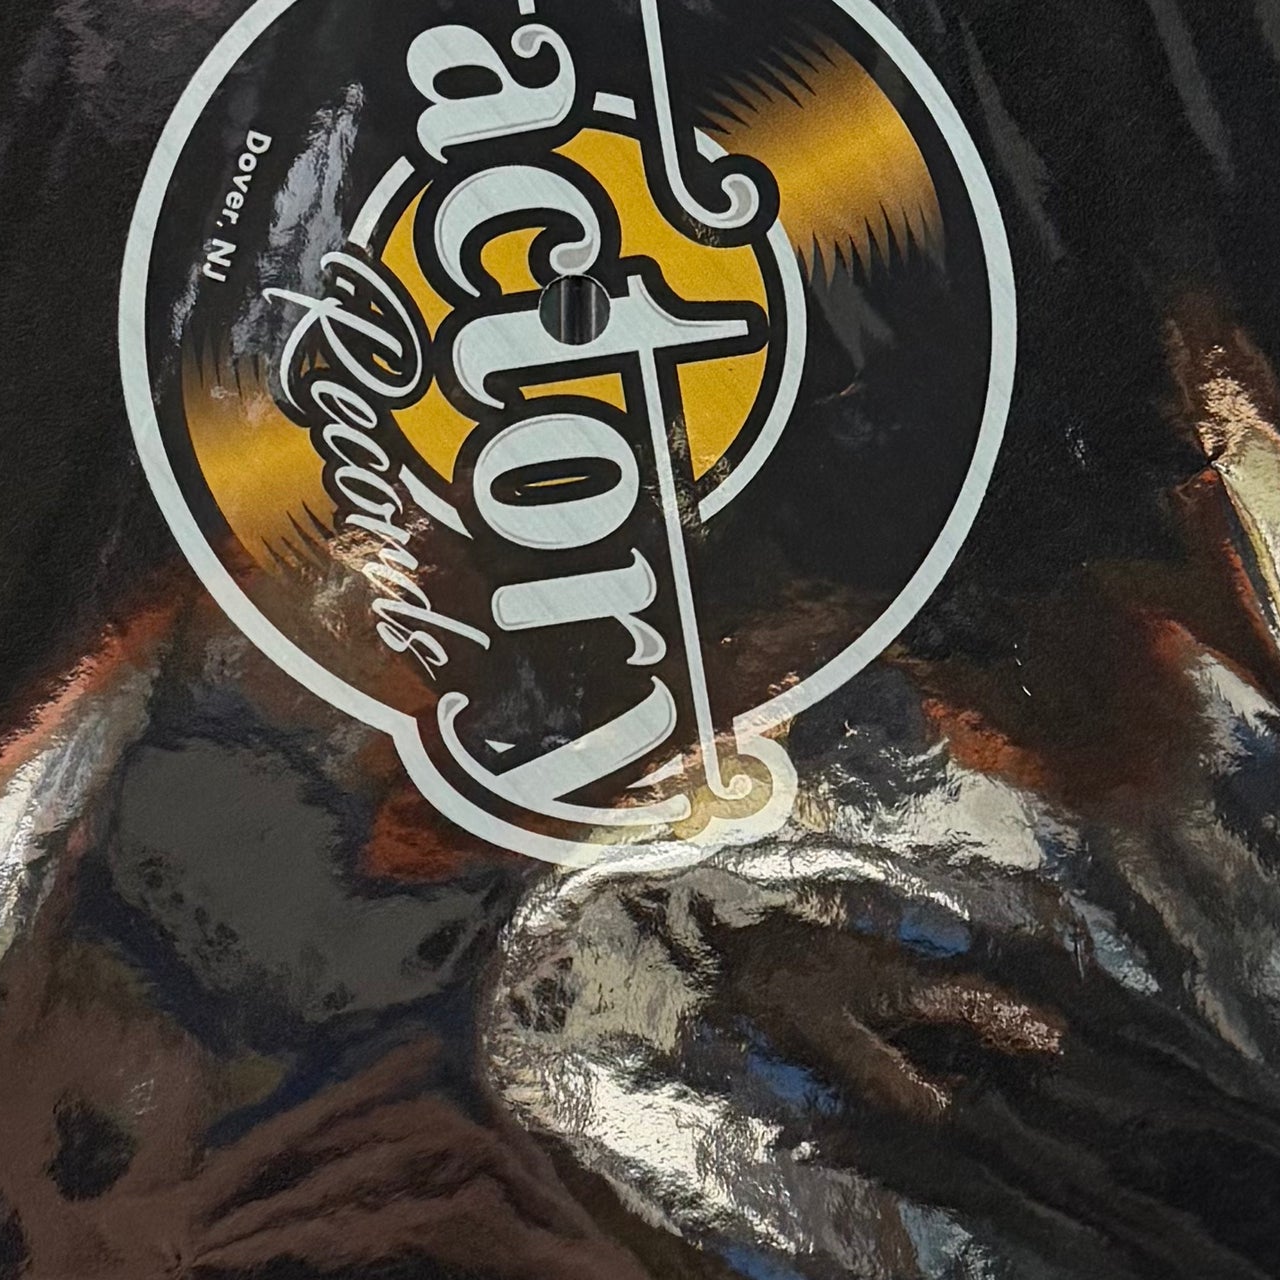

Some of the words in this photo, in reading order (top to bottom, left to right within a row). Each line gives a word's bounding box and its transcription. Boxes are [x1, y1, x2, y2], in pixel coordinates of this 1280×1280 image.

[216, 130, 272, 227] Dover,
[202, 238, 237, 283] NJ
[261, 250, 491, 681] Records
